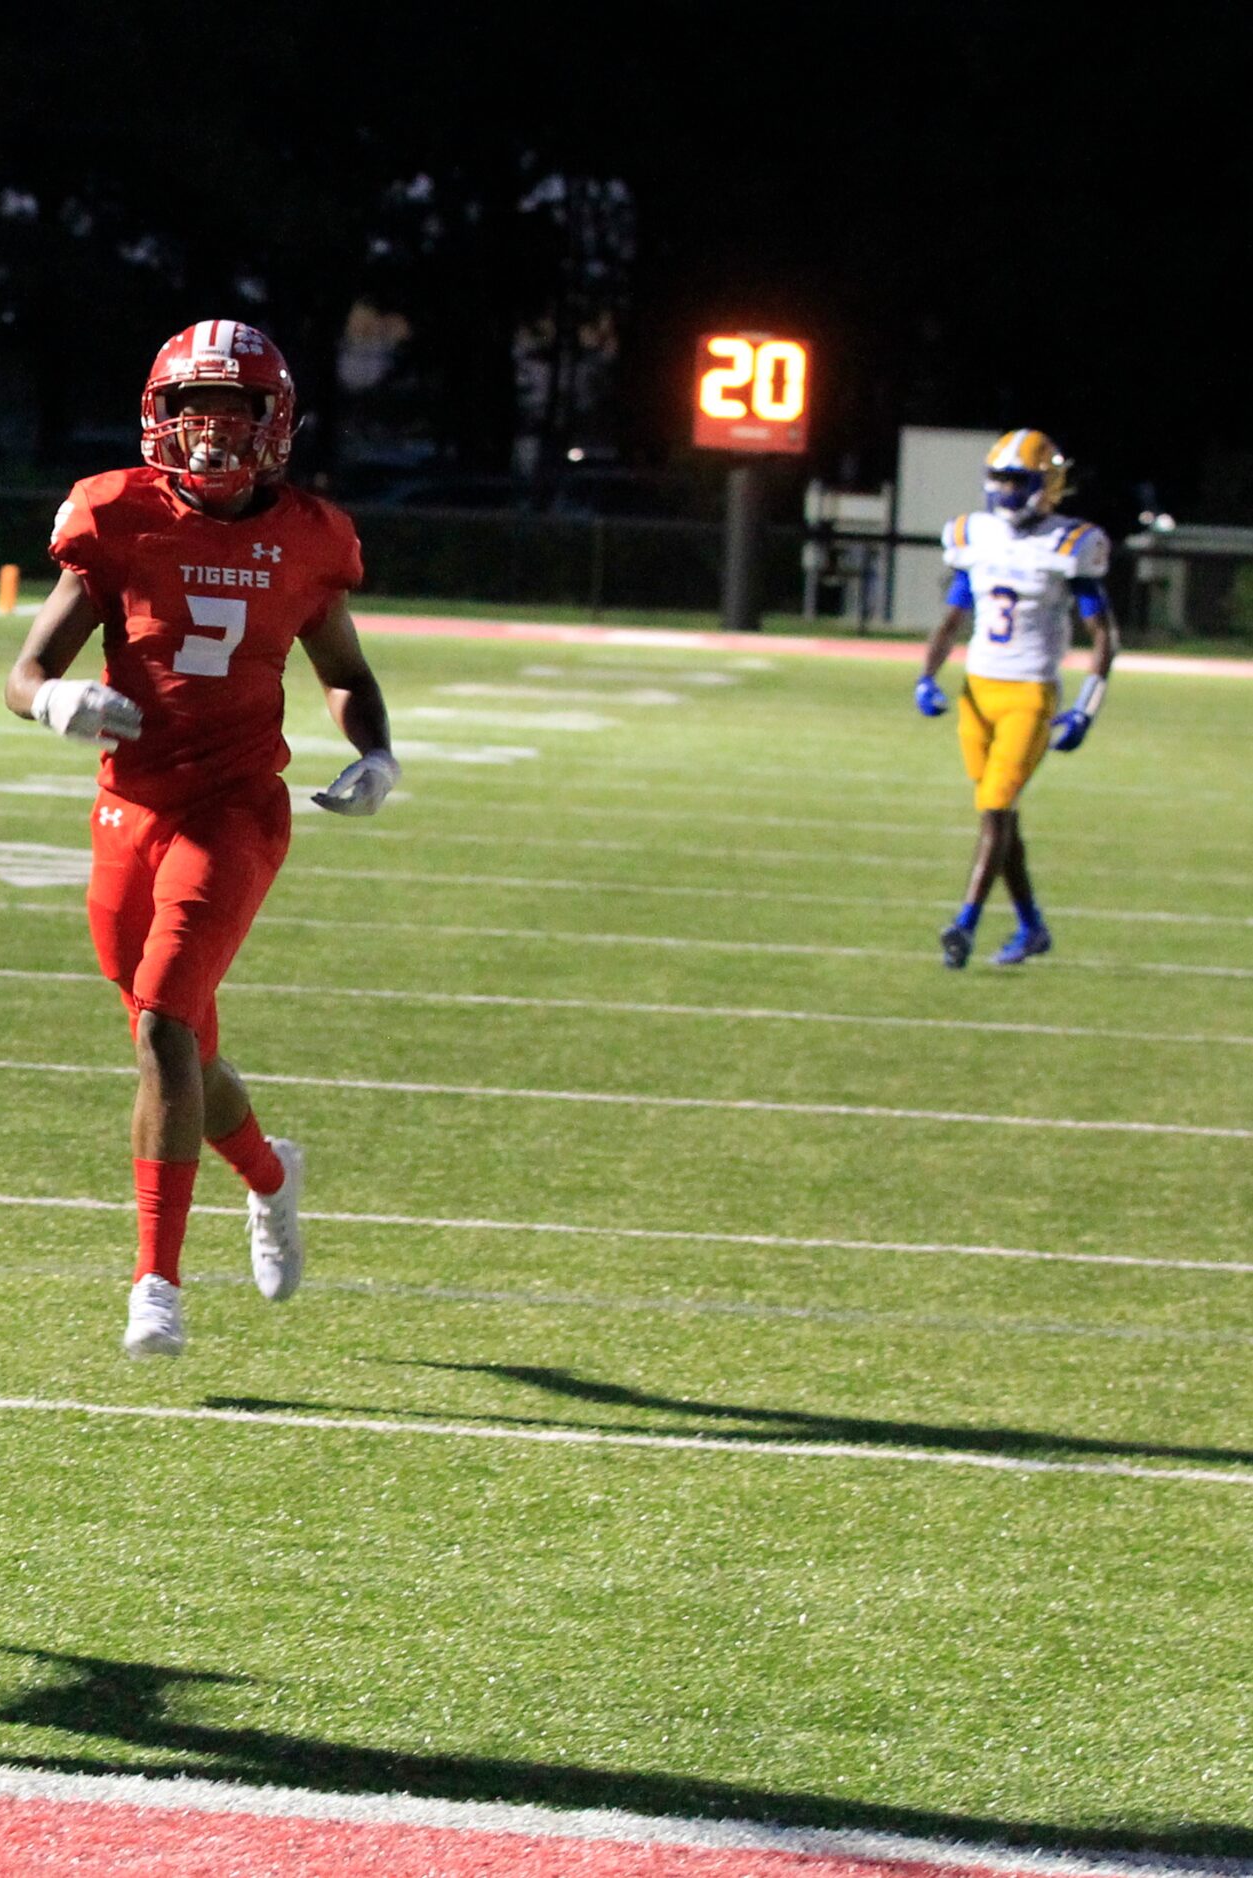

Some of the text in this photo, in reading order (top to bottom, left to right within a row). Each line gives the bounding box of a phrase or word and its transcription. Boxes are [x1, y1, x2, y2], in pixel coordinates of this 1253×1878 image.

[700, 336, 808, 422] 20
[179, 564, 270, 589] TIGERS
[988, 585, 1019, 645] 3
